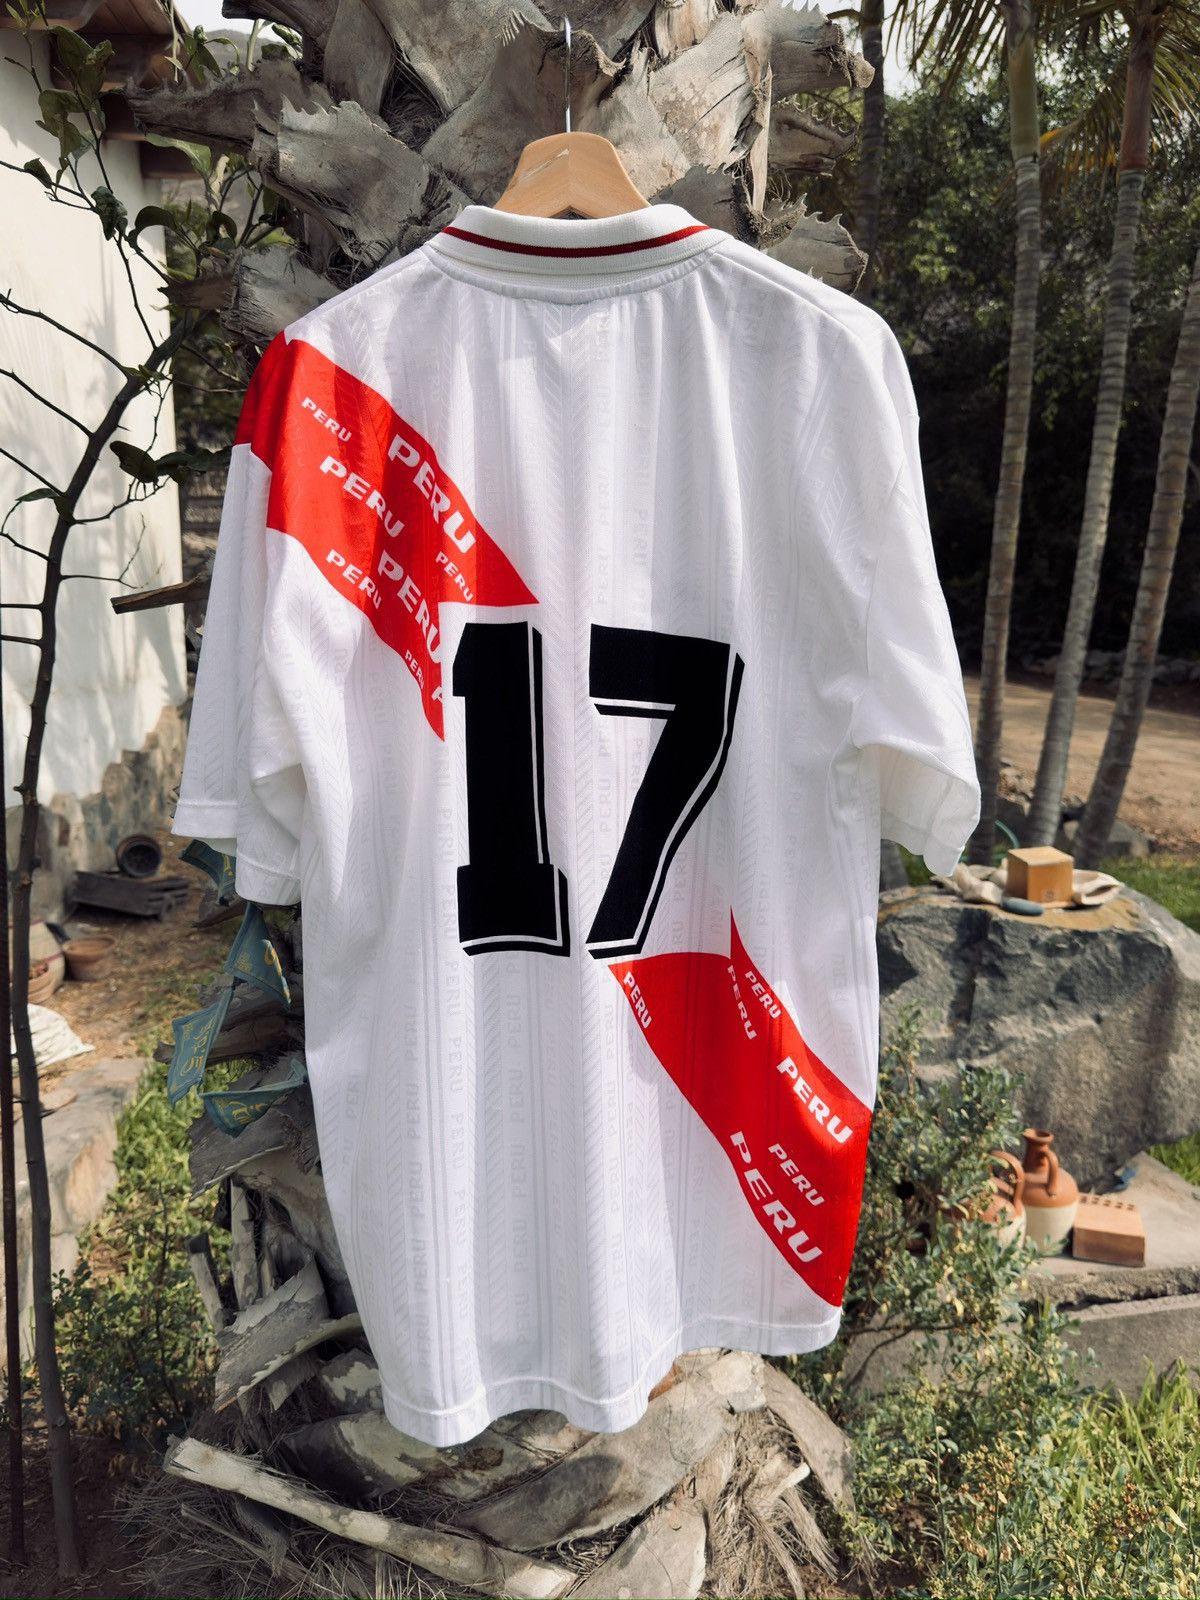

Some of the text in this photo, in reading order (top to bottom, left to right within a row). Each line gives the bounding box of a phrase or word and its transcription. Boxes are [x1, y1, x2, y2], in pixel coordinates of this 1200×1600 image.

[301, 397, 352, 442] PERU
[318, 455, 405, 538] PERU
[388, 434, 477, 556] PERU
[325, 548, 382, 609] PERU
[377, 550, 441, 664] PERU
[435, 551, 474, 603] PERU
[452, 621, 746, 960] 17
[622, 971, 652, 1029] PERU
[745, 971, 782, 1019] PERU
[776, 1056, 854, 1145] PERU
[729, 1131, 823, 1263] PERU
[768, 1143, 825, 1206] PERU
